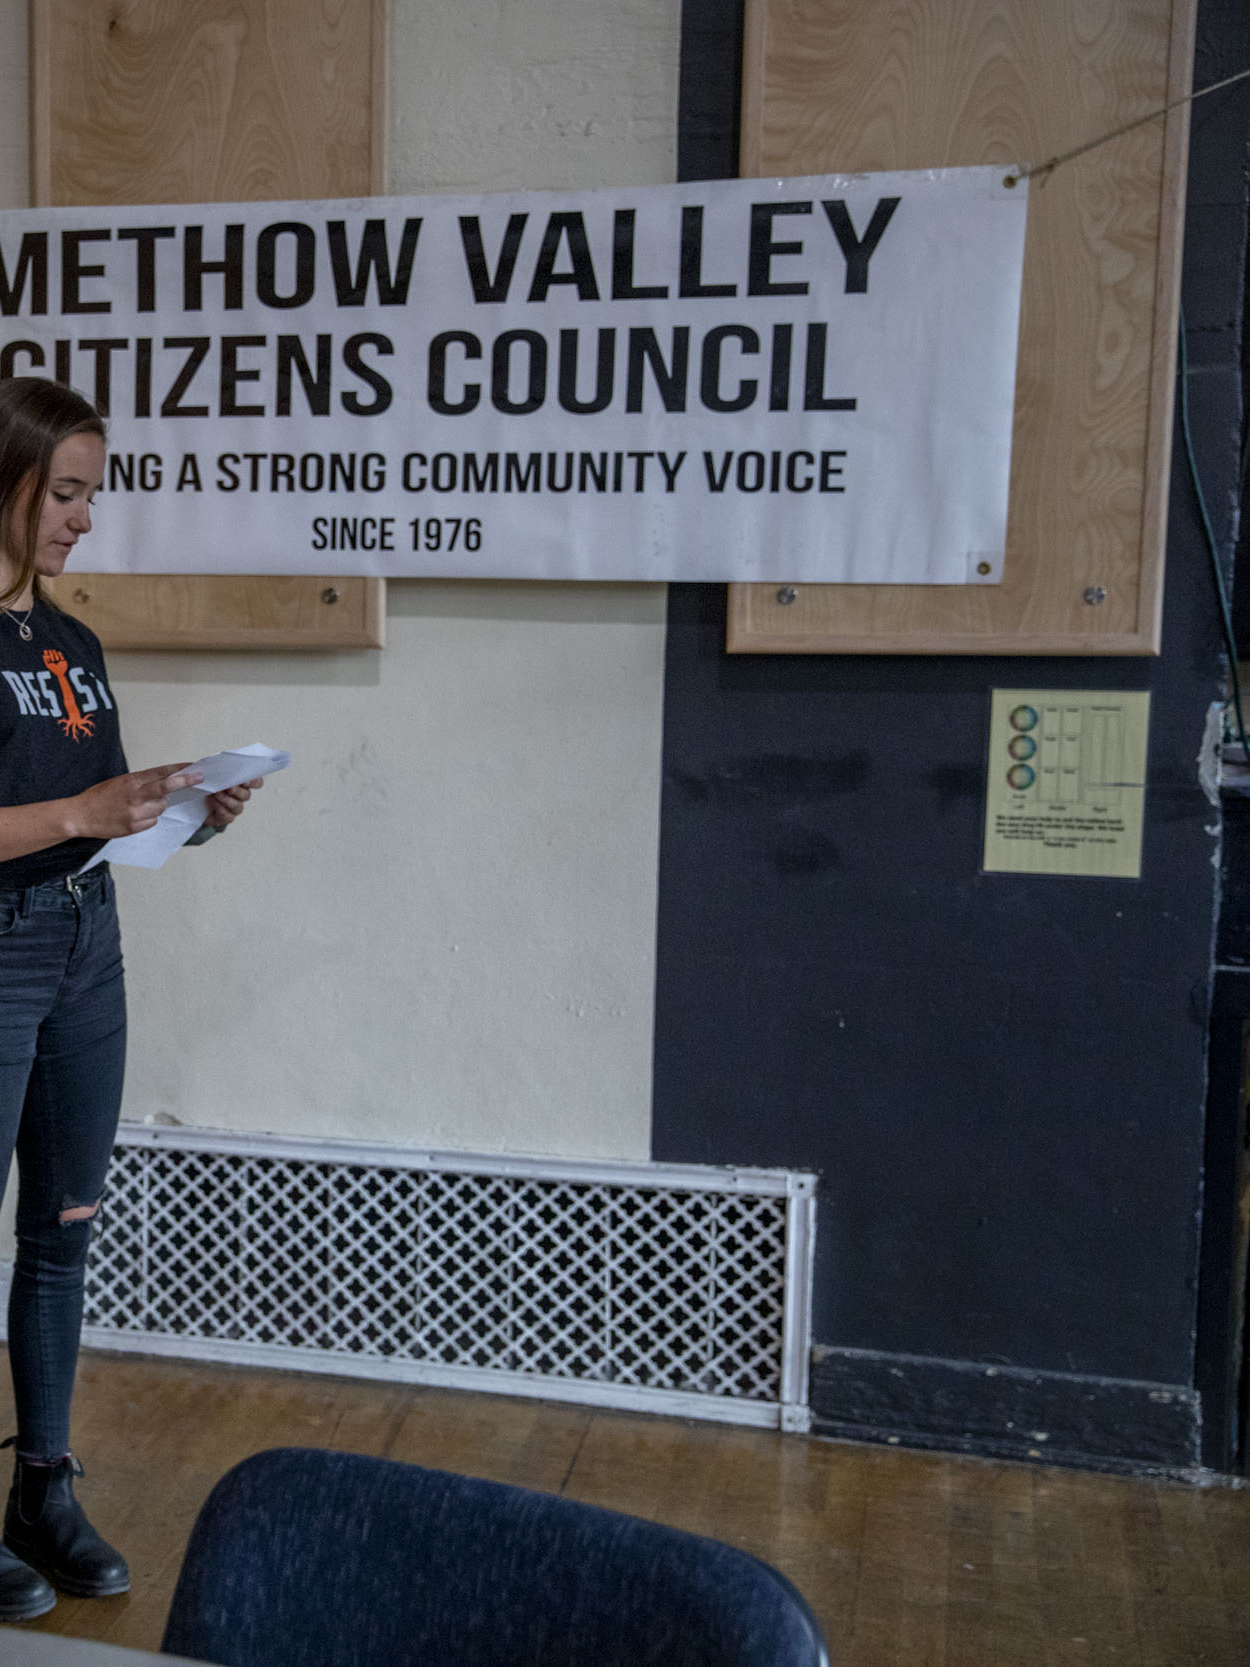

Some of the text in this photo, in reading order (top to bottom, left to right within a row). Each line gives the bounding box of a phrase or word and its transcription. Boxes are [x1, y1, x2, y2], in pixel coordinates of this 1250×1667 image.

[458, 197, 902, 304] VALLEY
[427, 323, 857, 414] COUNCIL
[176, 453, 203, 493] A
[217, 453, 386, 493] STRONG
[402, 451, 687, 493] COMMUNITY
[702, 451, 848, 493] VOICE
[311, 517, 482, 551] SINCE 1976
